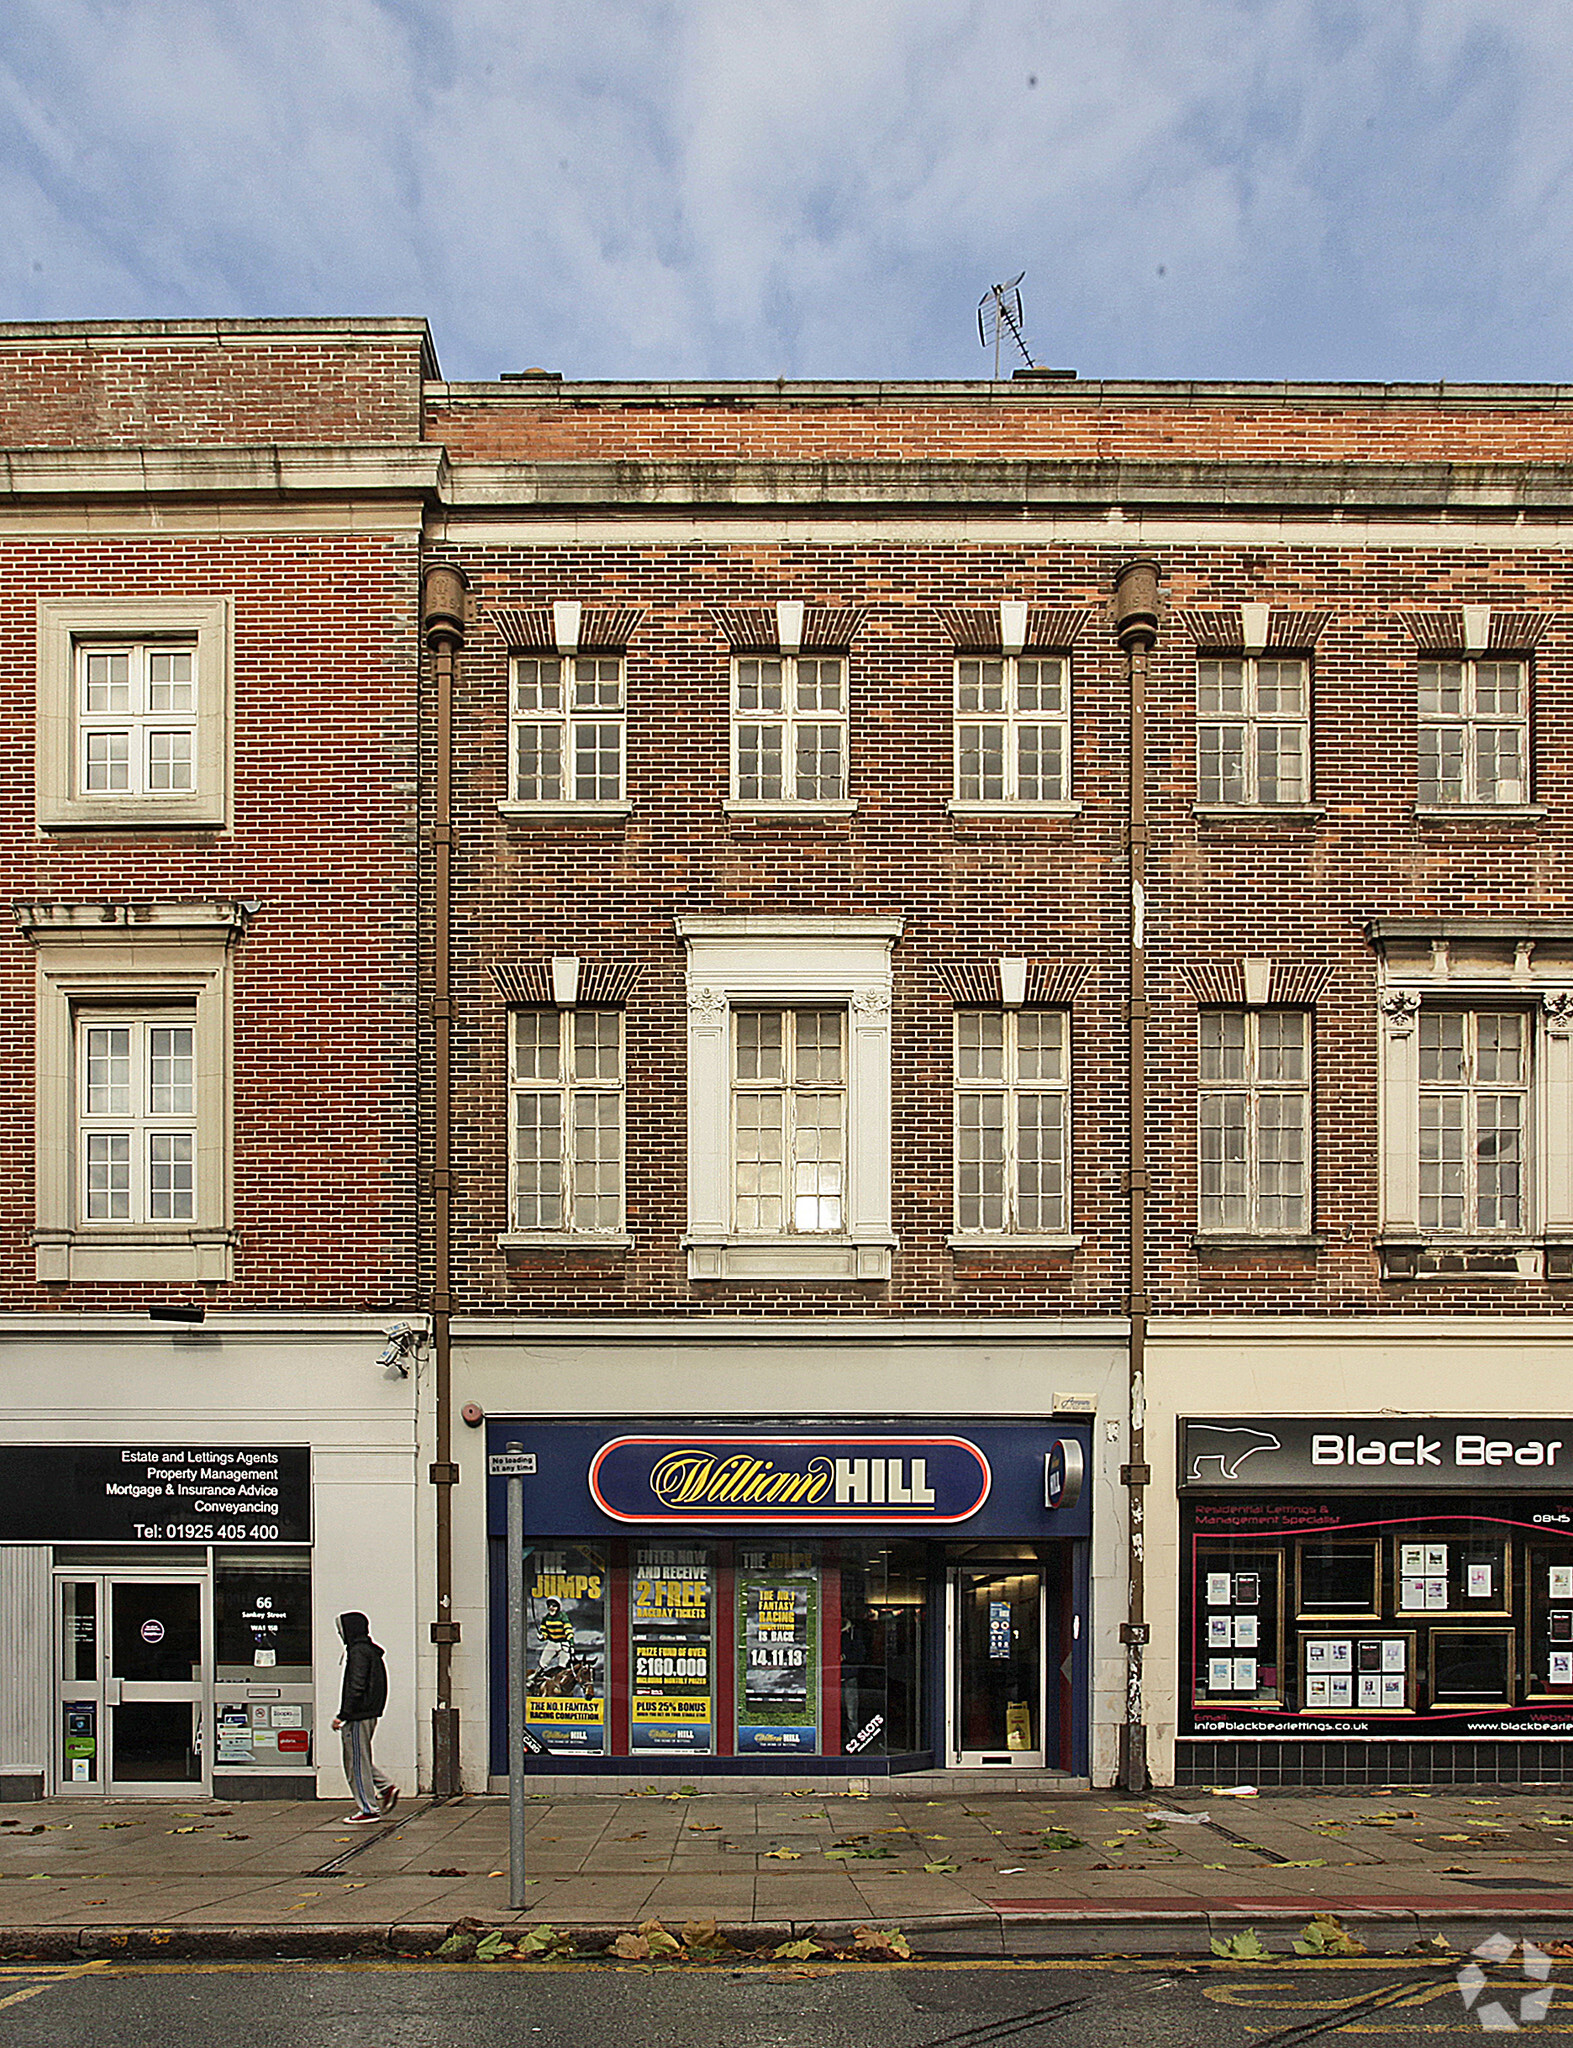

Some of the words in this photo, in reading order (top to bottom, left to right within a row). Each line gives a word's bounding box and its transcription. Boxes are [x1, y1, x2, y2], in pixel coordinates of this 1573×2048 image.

[1312, 1434, 1442, 1466] Black
[1456, 1434, 1563, 1466] Bear
[121, 1450, 159, 1463] Estate
[161, 1451, 185, 1463] and
[187, 1451, 235, 1466] Lettings
[236, 1451, 279, 1466] Agents
[505, 1456, 533, 1465] loading
[147, 1467, 198, 1482] Property
[200, 1467, 279, 1483] Management
[502, 1465, 515, 1473] any
[650, 1449, 834, 1505] William
[835, 1458, 935, 1503] HILL
[105, 1483, 163, 1498] Mortgage
[165, 1484, 175, 1495] &
[178, 1484, 236, 1496] Insurance
[237, 1484, 279, 1497] Advice
[194, 1500, 279, 1516] Conveyancing
[1195, 1505, 1264, 1514] Residential
[1195, 1516, 1279, 1526] Management
[1282, 1516, 1341, 1525] Specialist
[1532, 1514, 1571, 1523] 0845
[134, 1524, 162, 1539] Tel:
[166, 1524, 214, 1539] 01925
[217, 1524, 246, 1539] 405
[249, 1525, 279, 1540] 400
[533, 1550, 567, 1574] THE
[637, 1549, 675, 1565] ENTER
[677, 1549, 707, 1565] NOW
[742, 1553, 766, 1569] THE
[636, 1566, 661, 1580] AND
[662, 1566, 707, 1580] RECEIVE
[531, 1574, 602, 1599] JUMPS
[636, 1580, 652, 1607] 2
[654, 1580, 707, 1607] FREE
[759, 1590, 775, 1601] THE
[256, 1596, 273, 1609] 66
[758, 1601, 795, 1611] FANTASY
[266, 1611, 287, 1619] Street
[636, 1607, 674, 1618] RACEDAY
[675, 1608, 707, 1619] TICKETS
[758, 1611, 796, 1623] RACING
[758, 1631, 769, 1642] IS
[770, 1631, 796, 1642] BACK
[751, 1649, 803, 1667] 14.11.13
[530, 1701, 546, 1711] THE
[564, 1702, 600, 1712] FANTASY
[636, 1702, 658, 1712] PLUS
[658, 1702, 677, 1712] 25%
[677, 1702, 707, 1713] BONUS
[529, 1711, 555, 1720] RACING
[555, 1712, 600, 1721] COMPETITION
[1194, 1721, 1369, 1731] info@blackbearlettings.co.uk
[570, 1730, 588, 1740] HILL
[676, 1729, 695, 1740] HILL
[782, 1733, 801, 1743] HILL
[845, 1738, 861, 1754] £2
[856, 1713, 884, 1742] SLOTS
